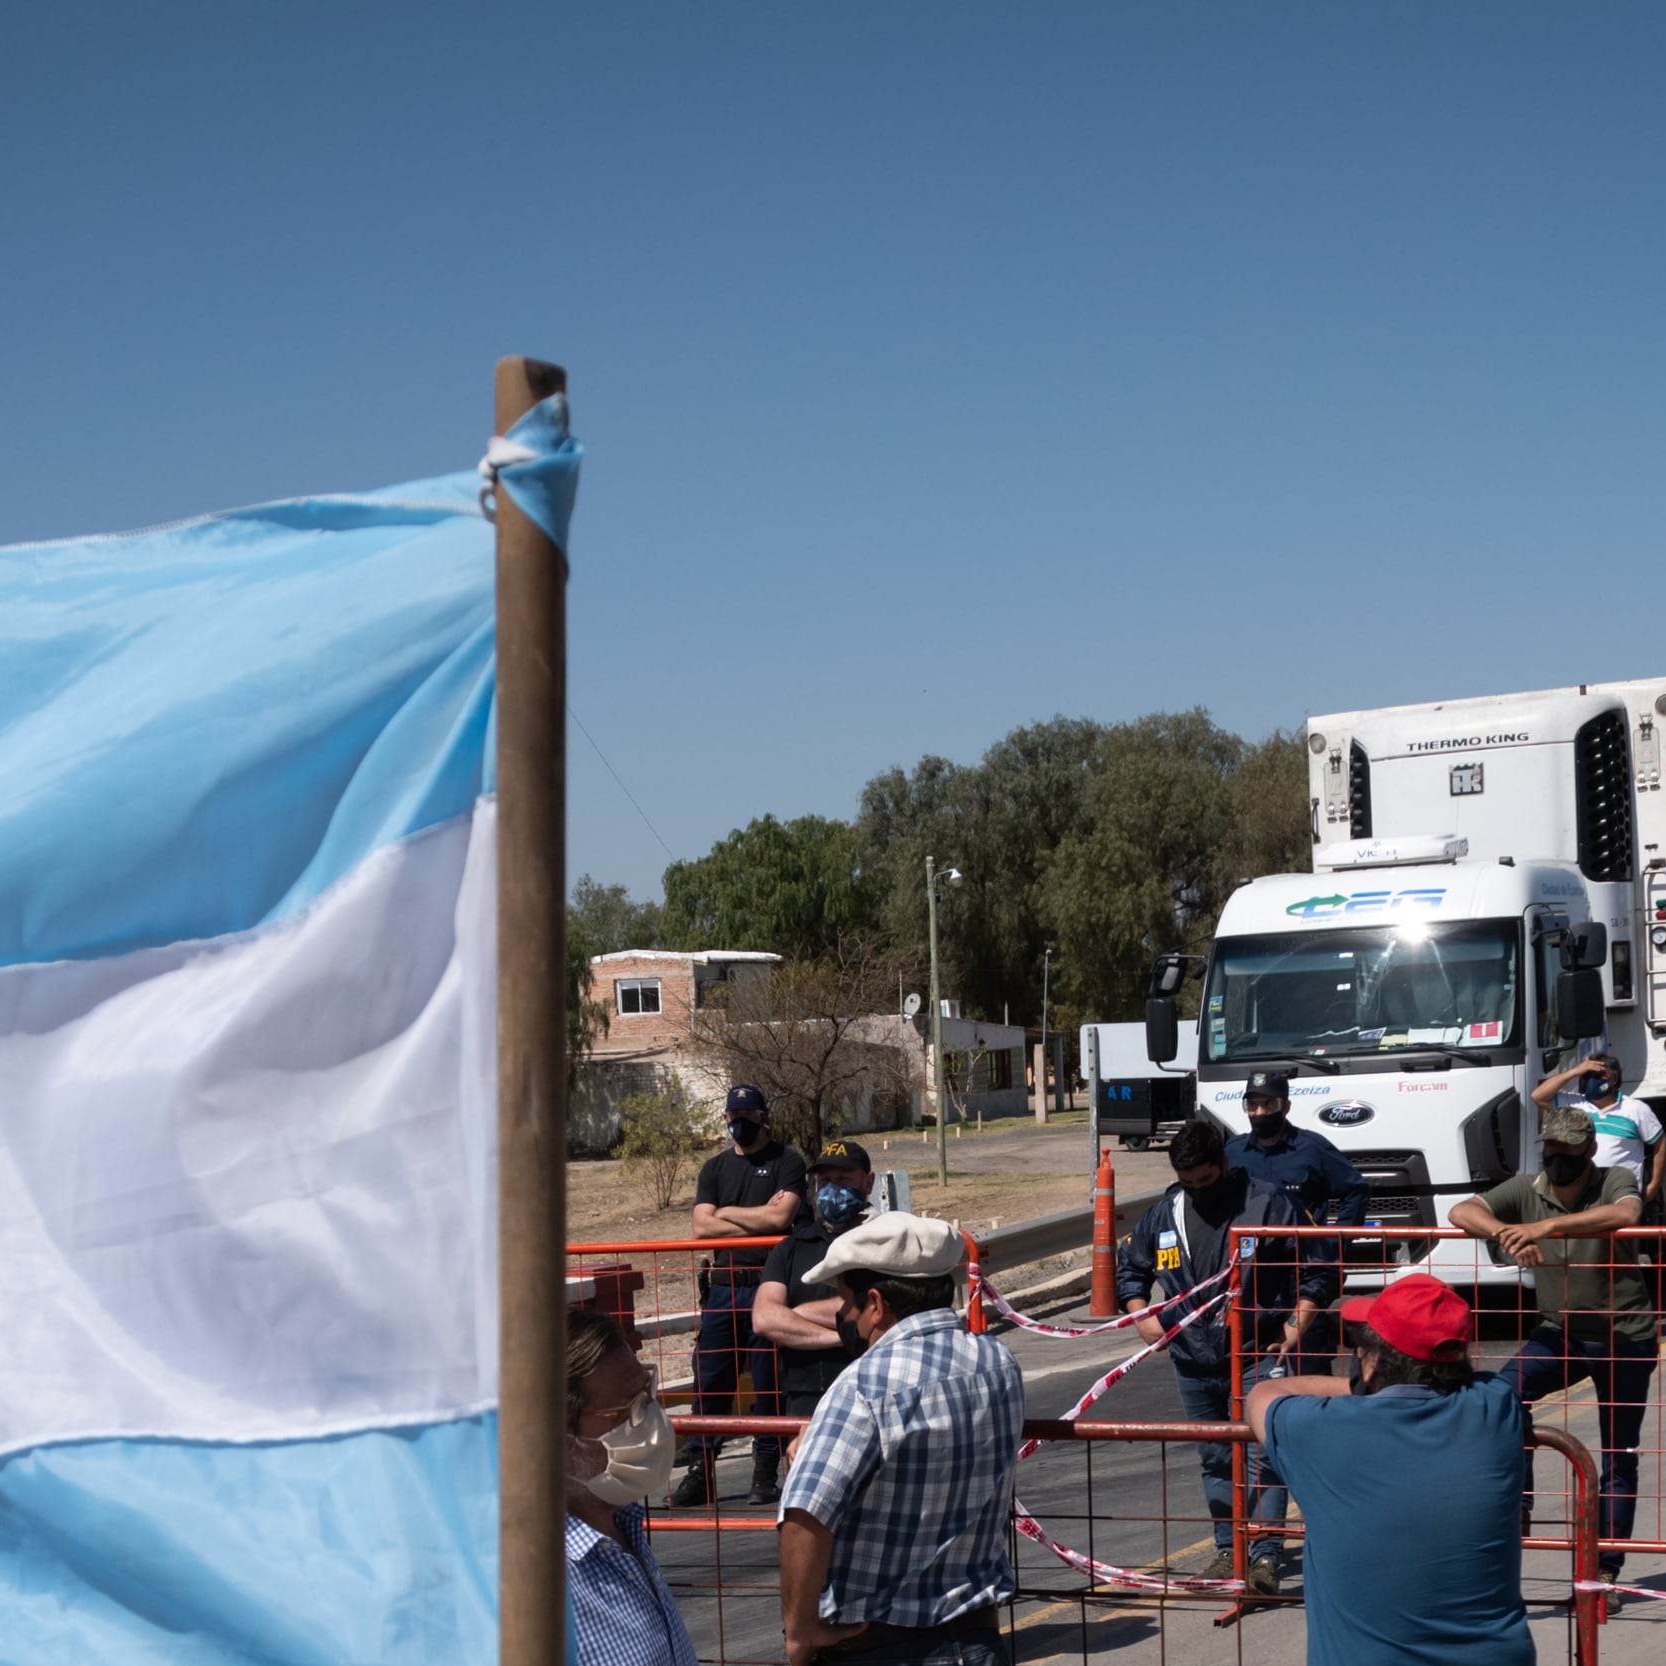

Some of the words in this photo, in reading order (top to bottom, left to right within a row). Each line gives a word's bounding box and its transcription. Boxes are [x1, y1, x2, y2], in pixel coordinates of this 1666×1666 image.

[1406, 737, 1481, 752] THERMO
[1486, 732, 1530, 745] KING
[1329, 1105, 1362, 1121] Ford
[1156, 1246, 1182, 1271] PFA
